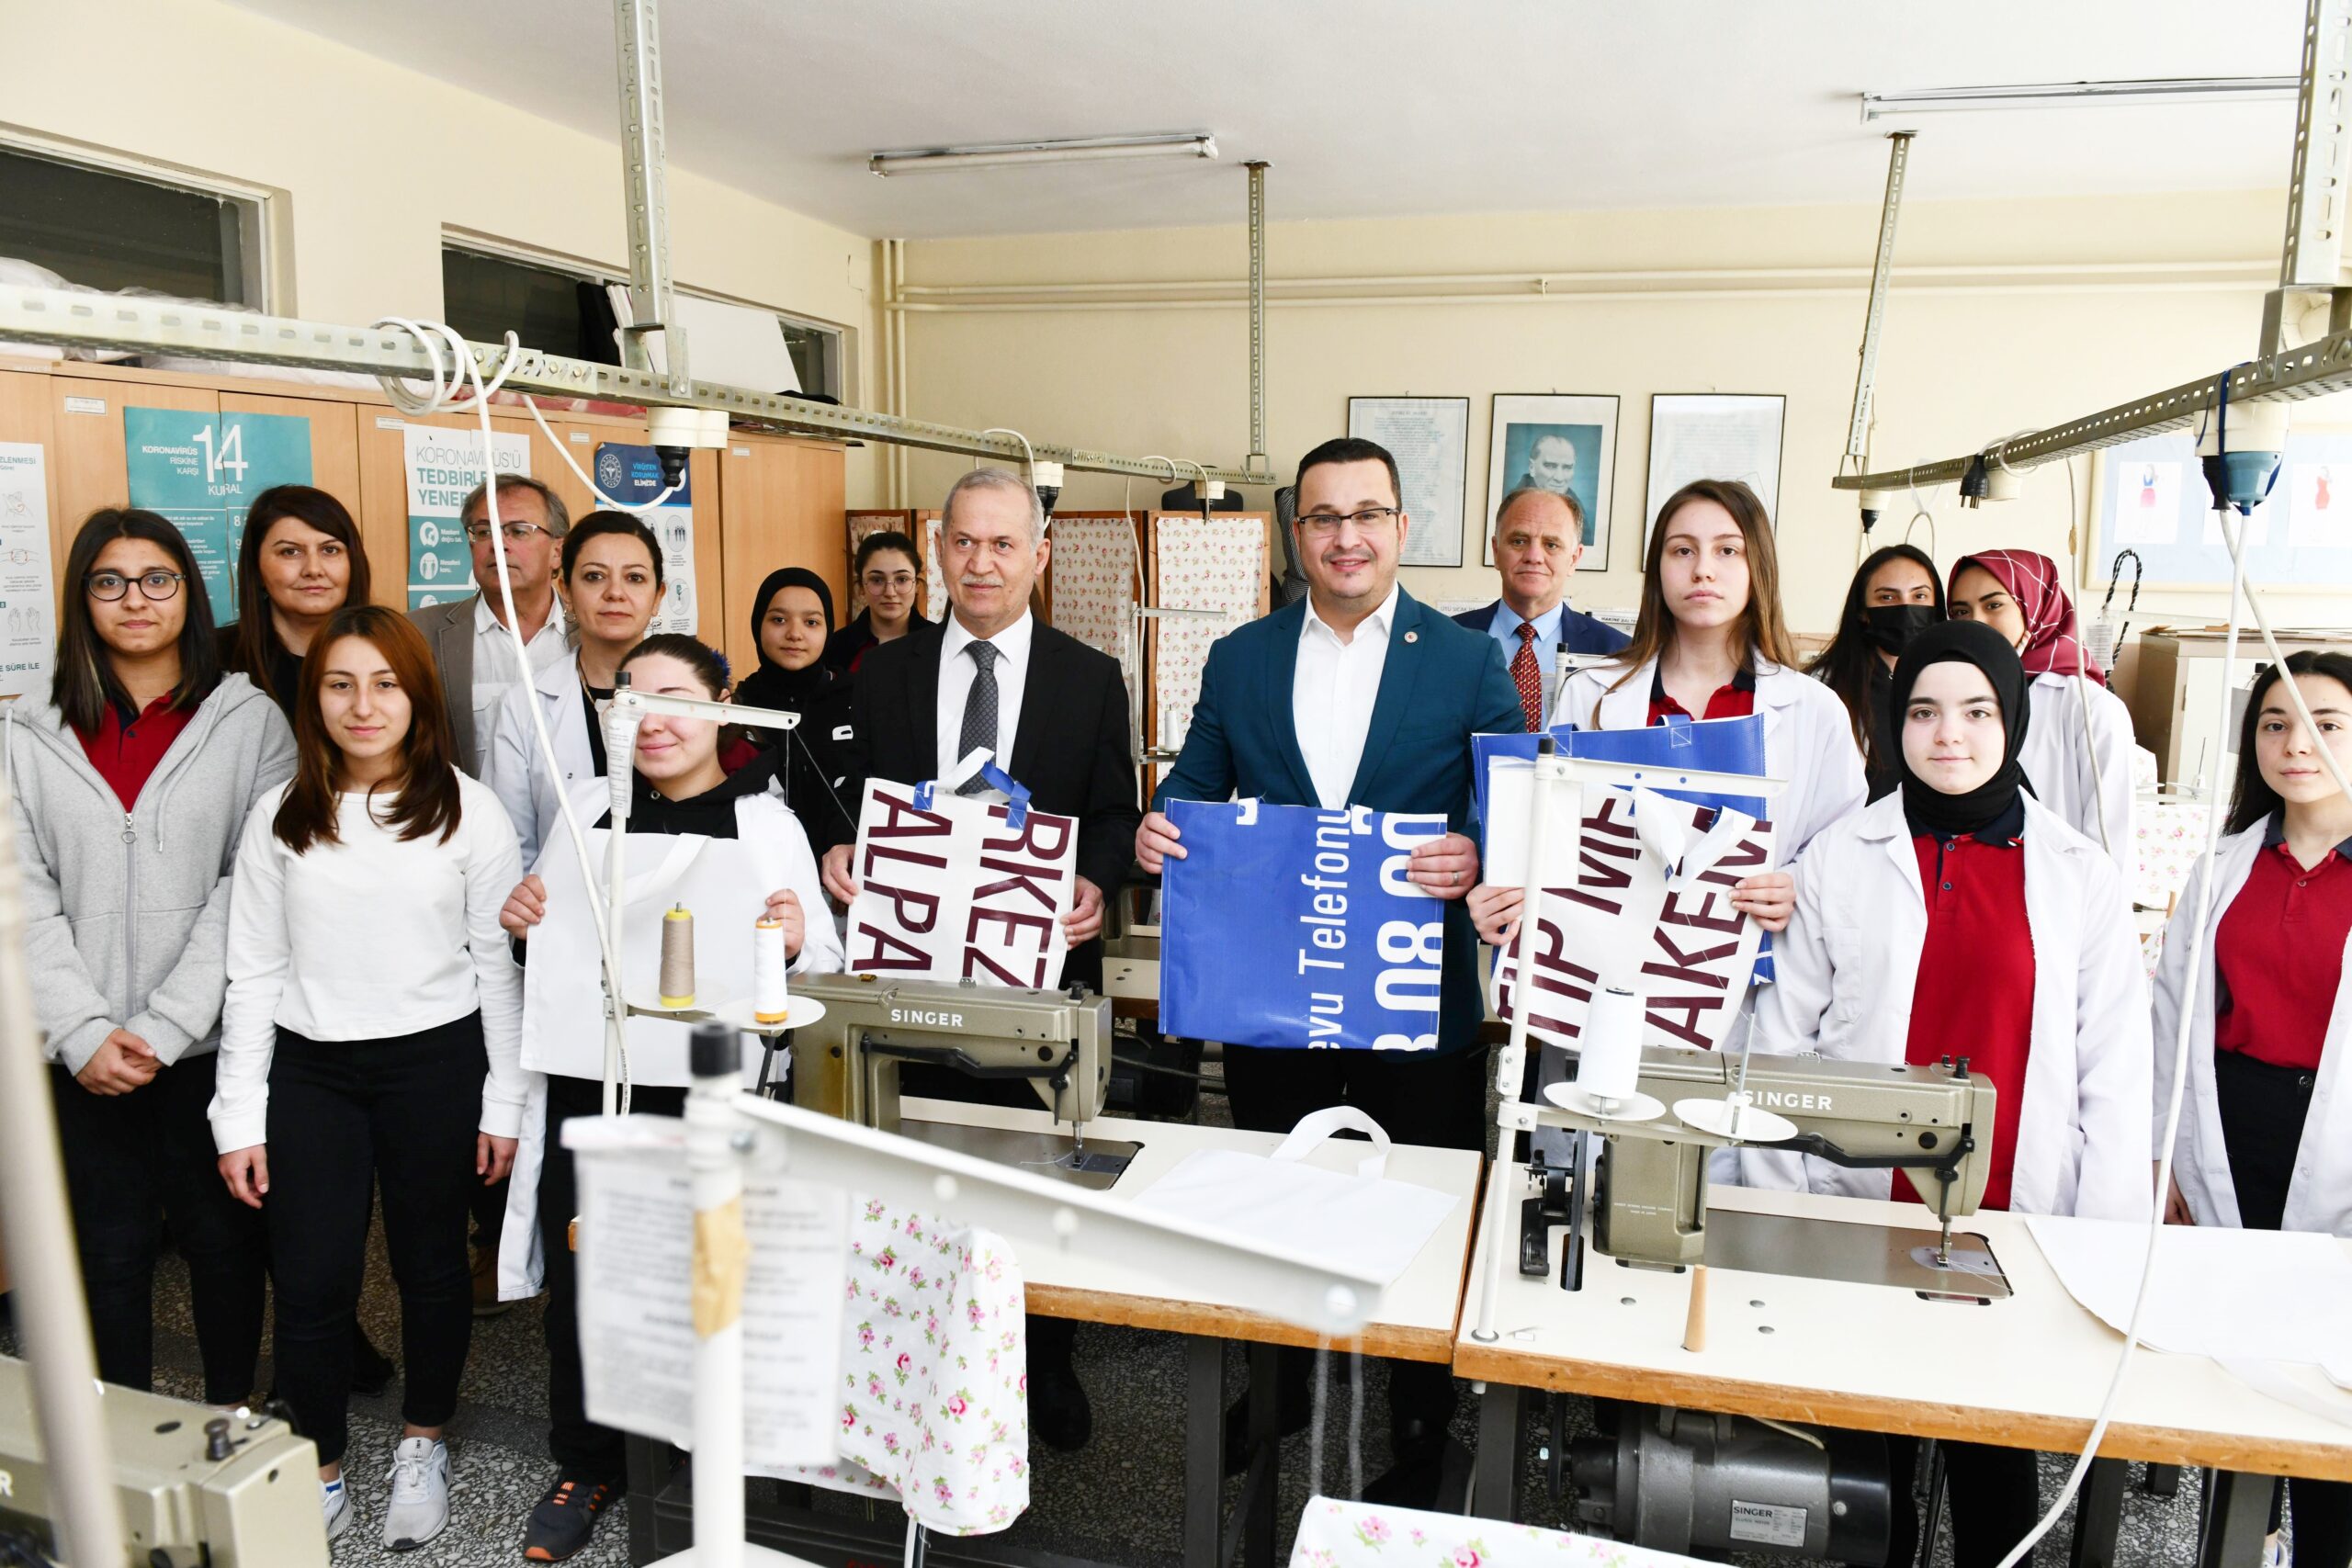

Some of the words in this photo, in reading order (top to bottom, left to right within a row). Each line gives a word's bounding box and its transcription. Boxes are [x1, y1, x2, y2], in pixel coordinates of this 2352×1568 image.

[141, 446, 198, 456] KORONAVİRÜS
[192, 424, 249, 483] 14
[416, 446, 521, 468] KORONAVİÜS'Ü
[208, 483, 243, 496] KURAL
[233, 515, 242, 526] 8
[6, 662, 27, 671] SÜRE
[852, 788, 954, 972] ALPA
[890, 1009, 965, 1028] SINGER
[1742, 1089, 1833, 1111] SINGER
[1733, 1506, 1773, 1518] SINGER
